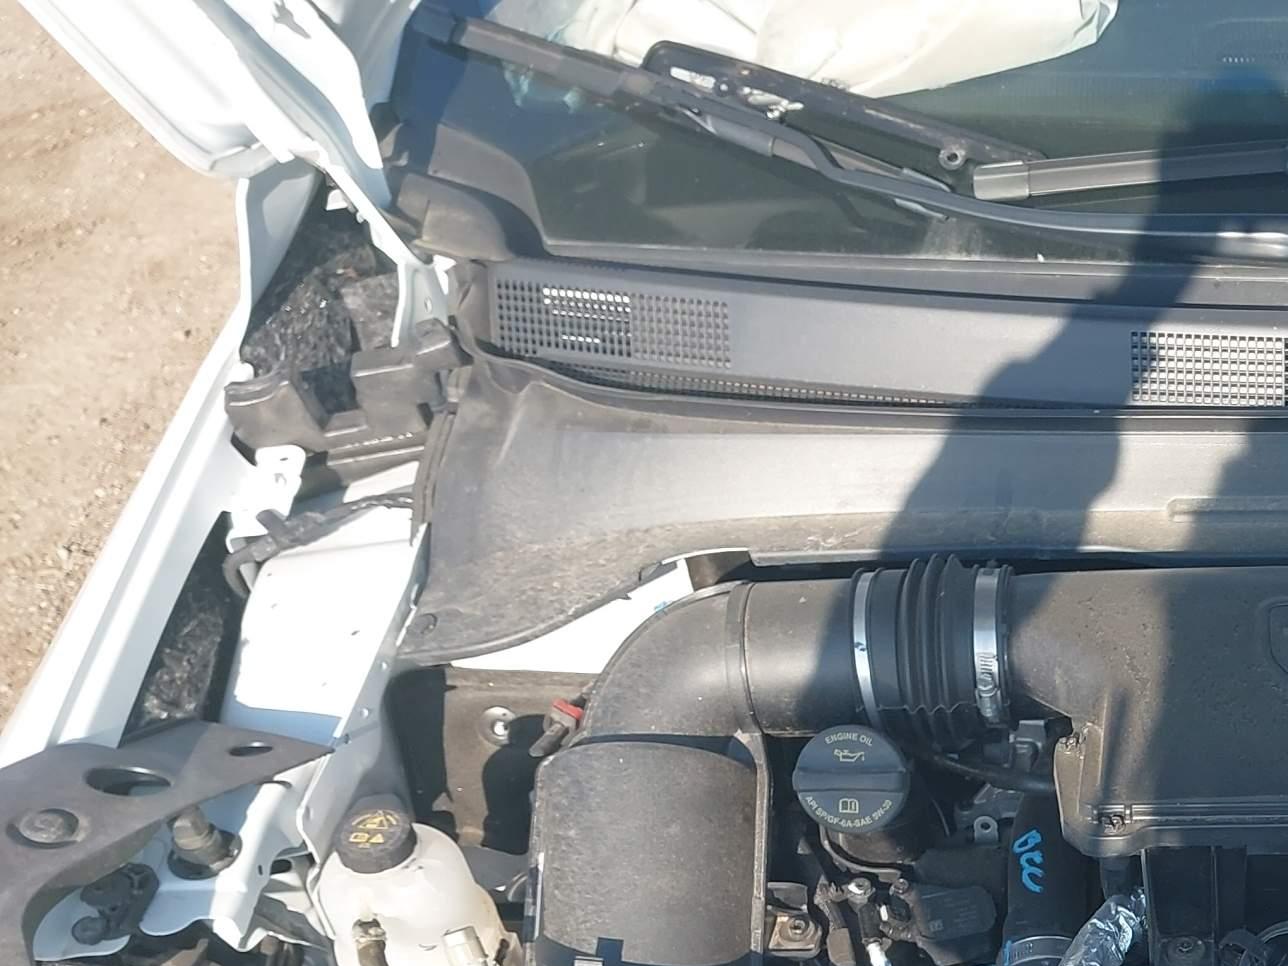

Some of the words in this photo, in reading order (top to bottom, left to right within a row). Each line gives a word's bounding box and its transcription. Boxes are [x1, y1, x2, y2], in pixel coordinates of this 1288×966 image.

[825, 732, 859, 745] ENGINE
[859, 735, 873, 746] OIL
[805, 796, 818, 810] API
